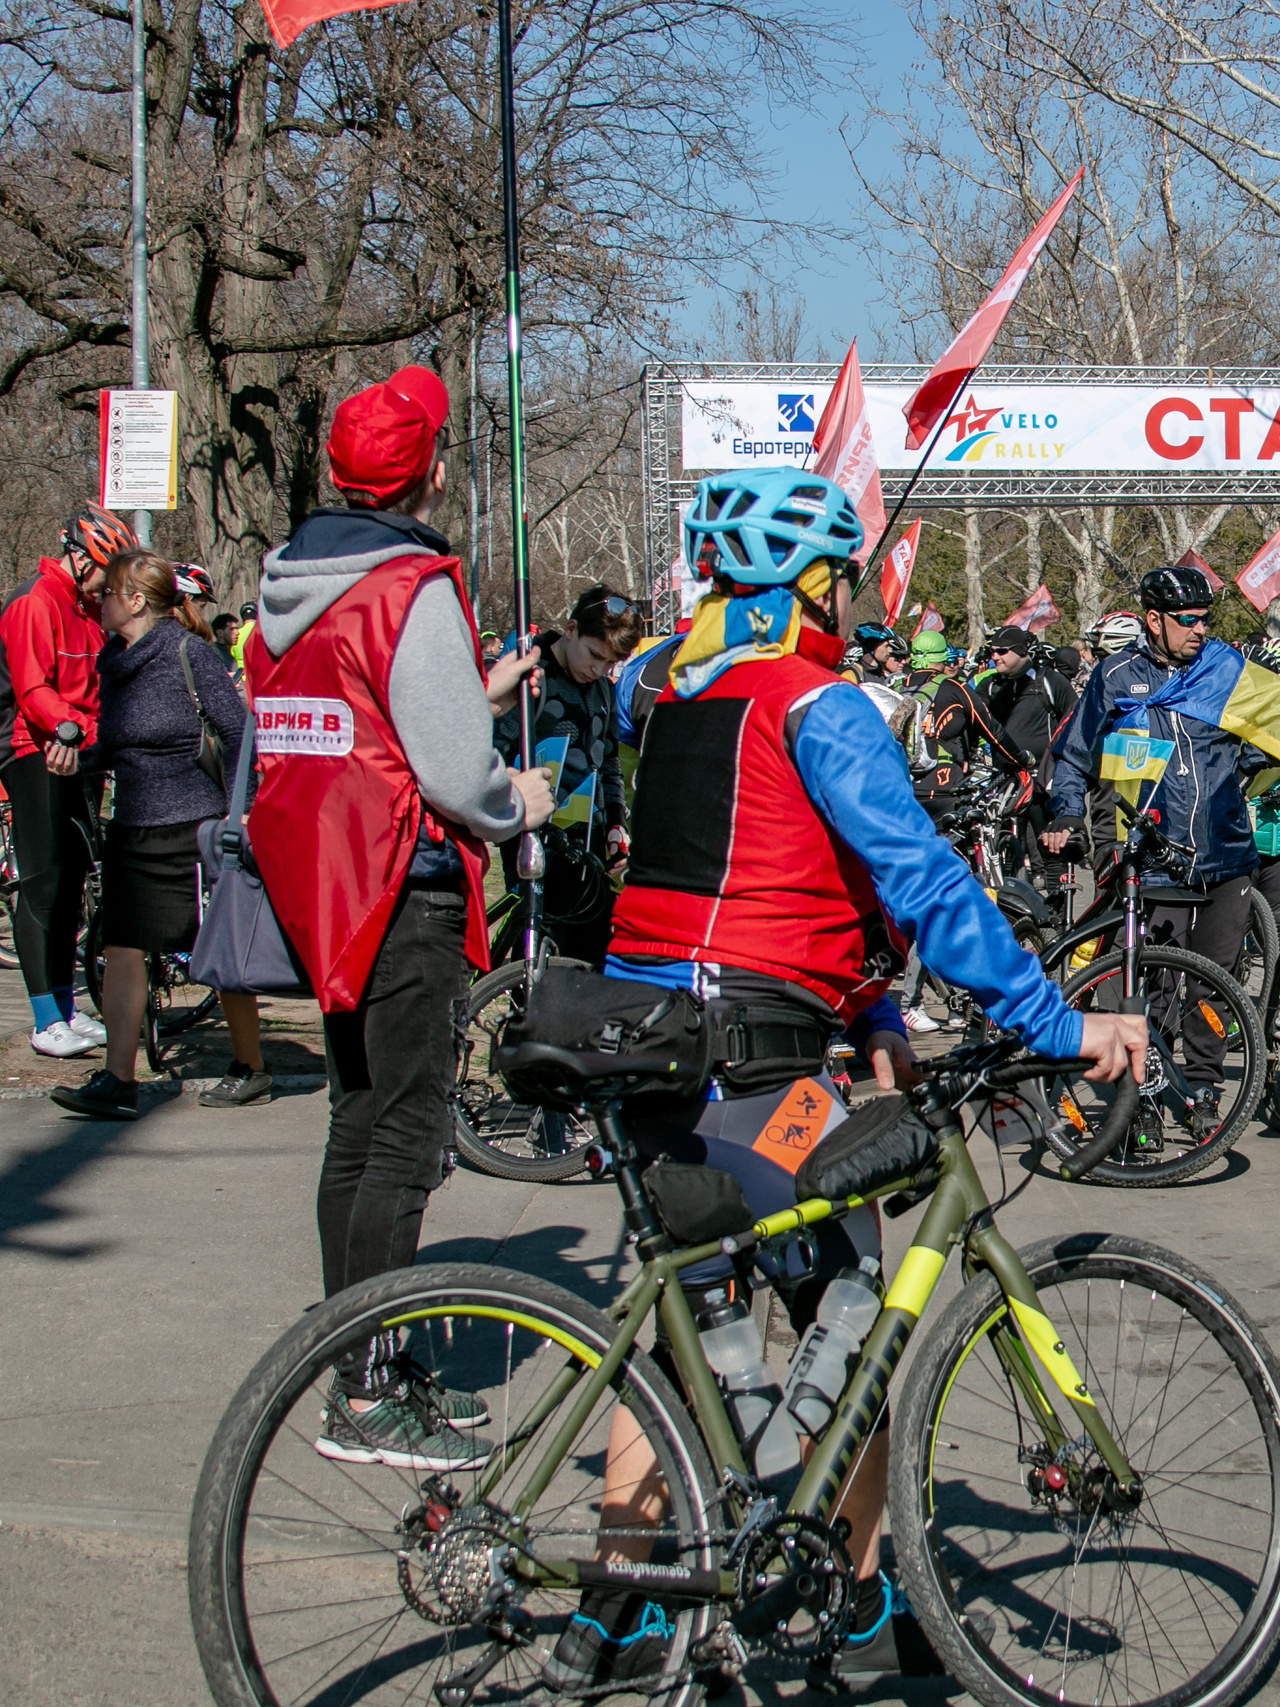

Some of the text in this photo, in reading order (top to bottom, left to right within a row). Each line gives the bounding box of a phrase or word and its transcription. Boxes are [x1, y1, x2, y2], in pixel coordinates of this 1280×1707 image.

[1001, 413, 1058, 429] VELO
[995, 443, 1065, 458] RALLY
[322, 714, 341, 732] В
